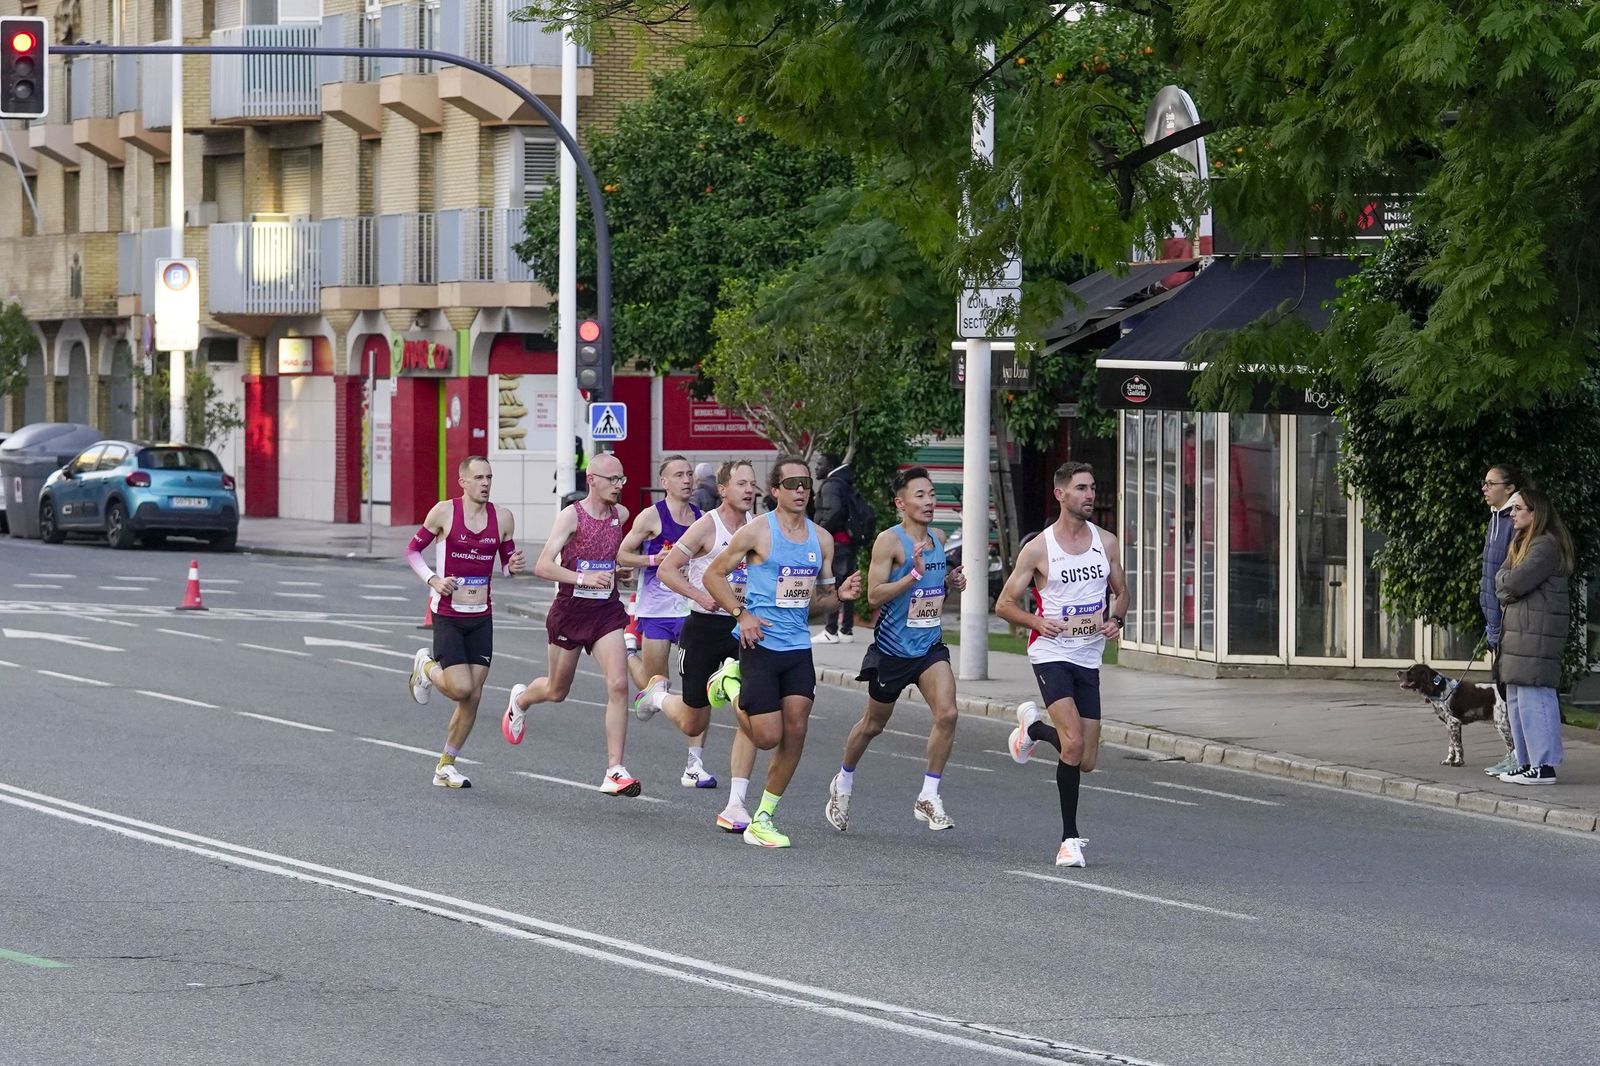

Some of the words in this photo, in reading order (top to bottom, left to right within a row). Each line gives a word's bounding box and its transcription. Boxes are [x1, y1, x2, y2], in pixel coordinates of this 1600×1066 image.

[967, 296, 988, 309] ZONA
[963, 317, 990, 329] SECTO
[1126, 382, 1147, 390] Estrella
[783, 588, 810, 598] JASPER
[1079, 604, 1099, 613] ZURIC
[1072, 624, 1097, 636] PACER
